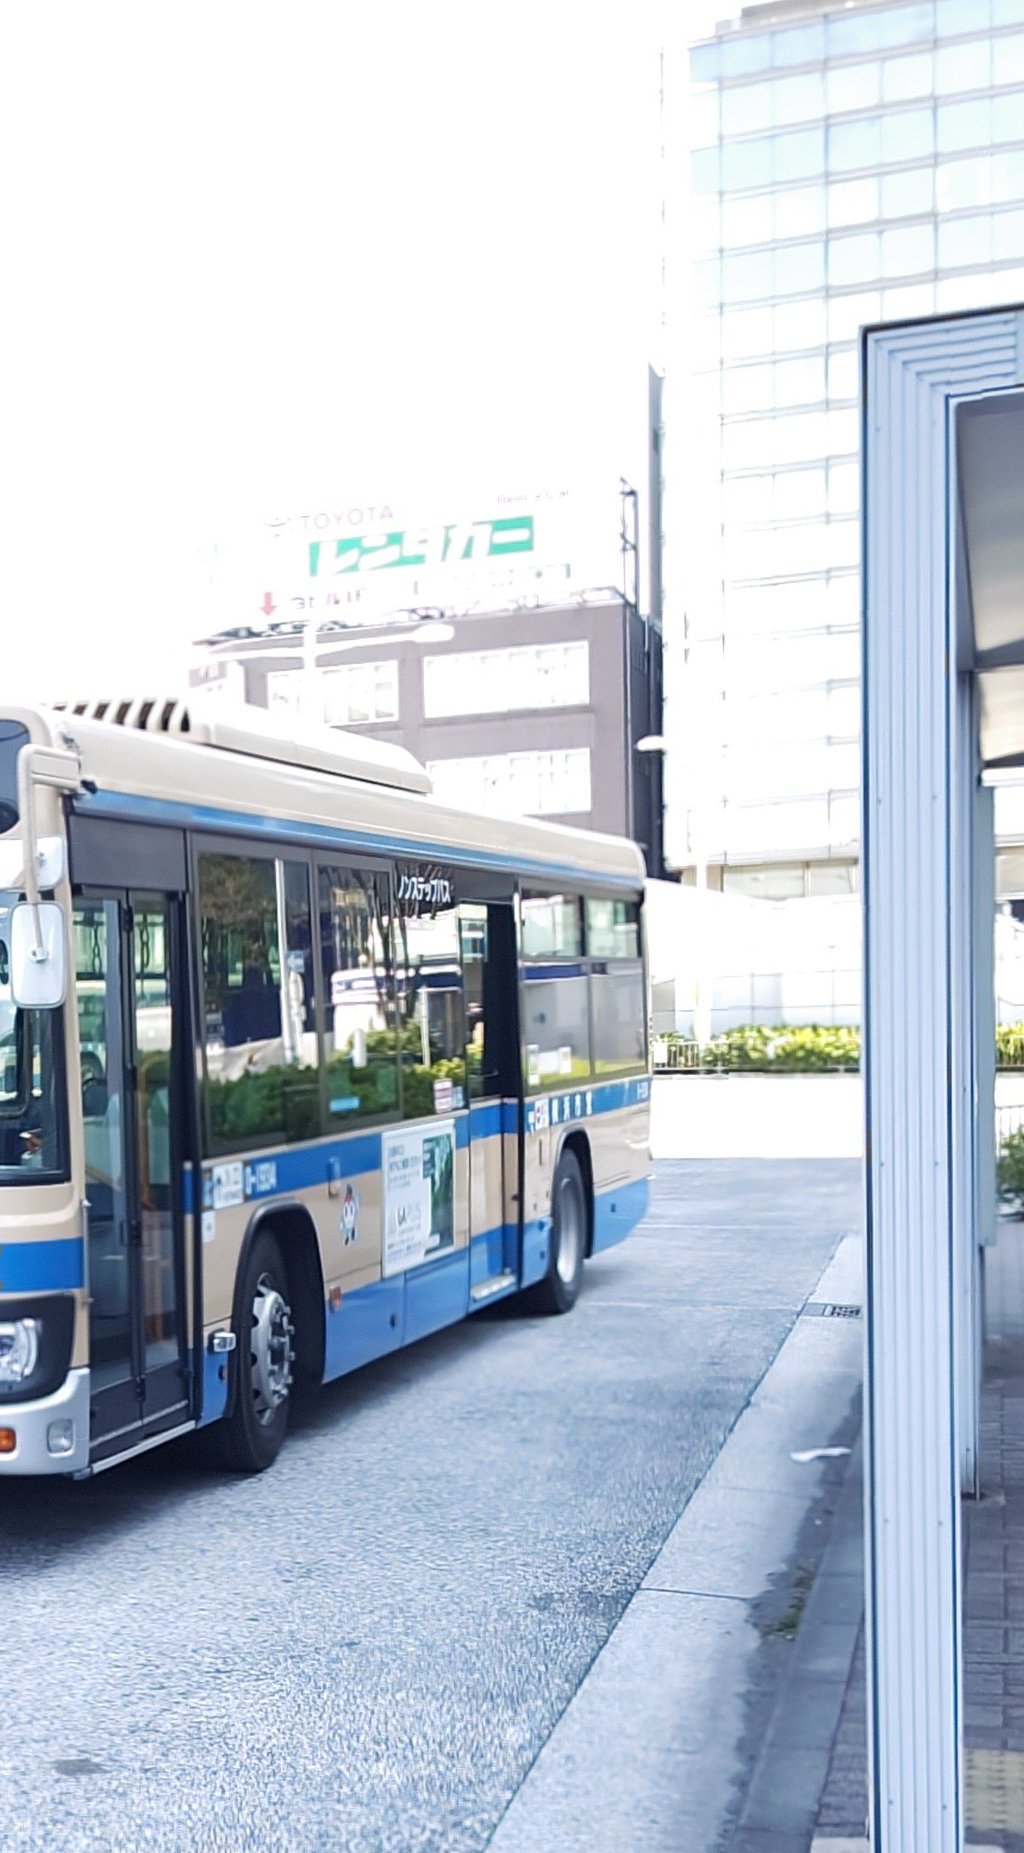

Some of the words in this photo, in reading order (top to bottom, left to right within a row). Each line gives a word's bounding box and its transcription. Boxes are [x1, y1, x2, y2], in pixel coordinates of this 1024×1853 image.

[300, 504, 394, 530] TOYOTA
[398, 874, 451, 904] ノンステップバス
